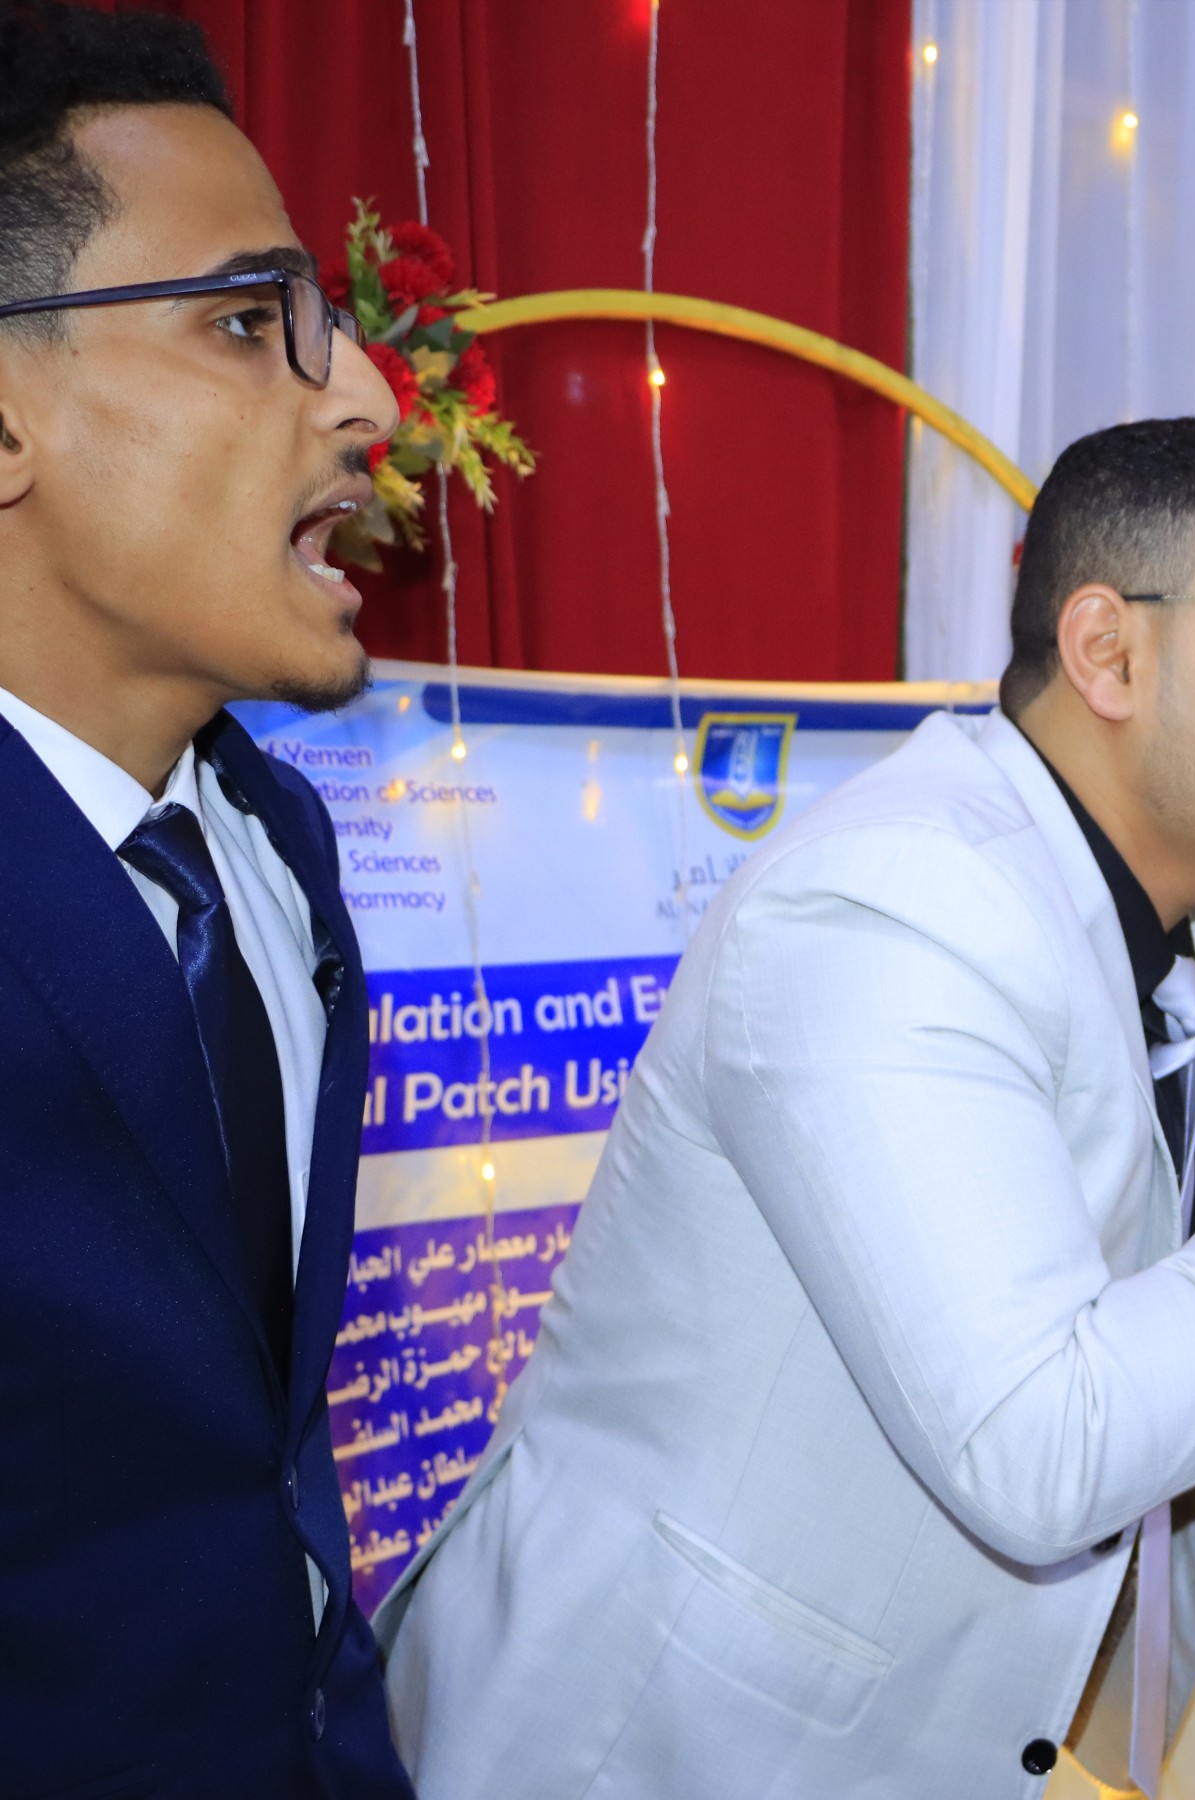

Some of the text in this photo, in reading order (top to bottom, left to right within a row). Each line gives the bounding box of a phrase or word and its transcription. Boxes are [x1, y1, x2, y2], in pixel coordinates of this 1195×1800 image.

[230, 273, 257, 281] GUCCI
[265, 740, 372, 766] f Yemen
[406, 780, 497, 803] Sciences
[334, 817, 392, 841] ersity
[348, 850, 441, 873] Sciences
[341, 888, 446, 912] harmacy
[534, 977, 624, 1032] and
[403, 1063, 550, 1123] Patch
[566, 1057, 631, 1108] Usi
[335, 1311, 387, 1346] محم
[413, 1396, 484, 1437] محمد
